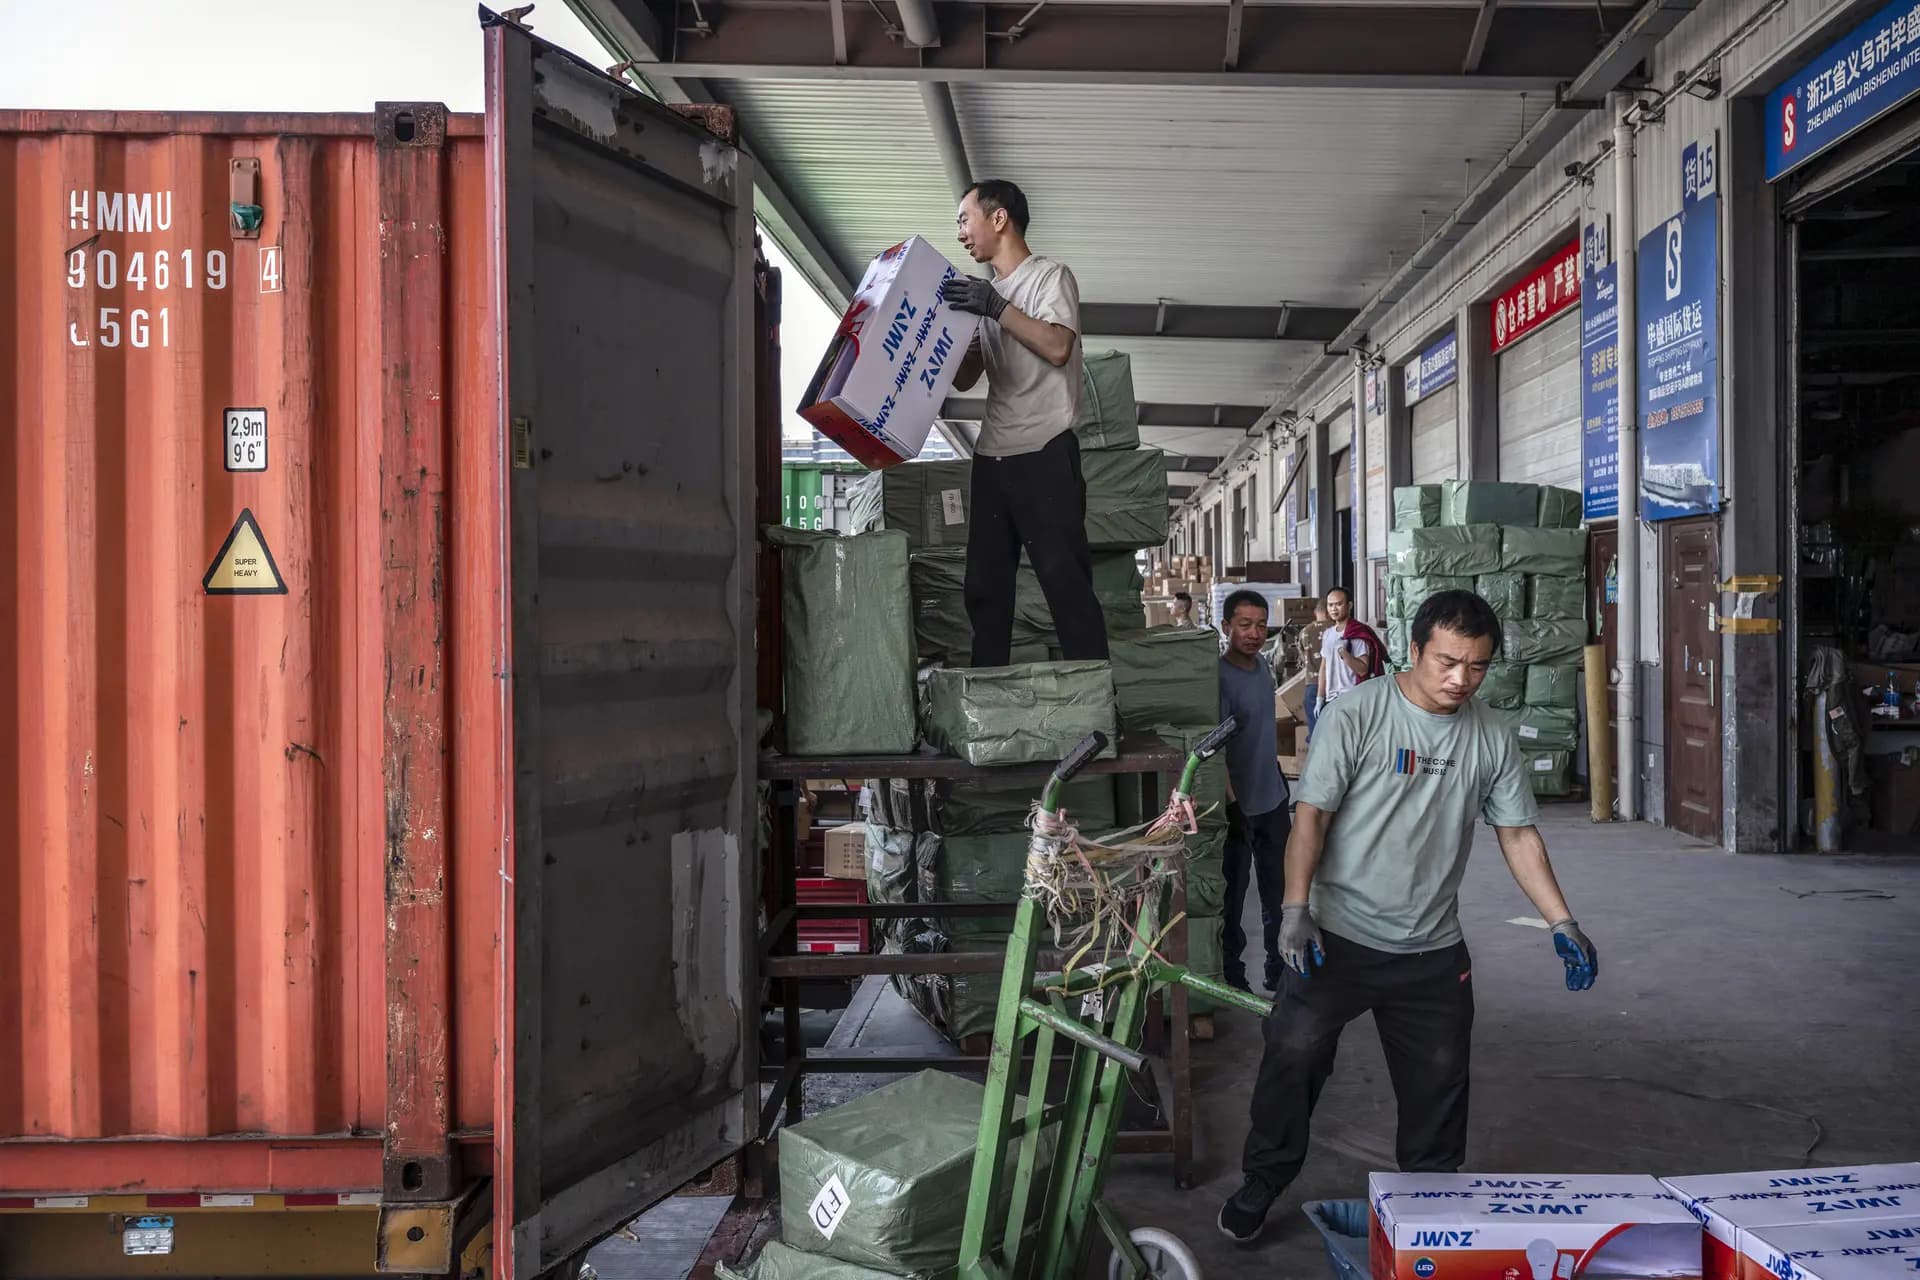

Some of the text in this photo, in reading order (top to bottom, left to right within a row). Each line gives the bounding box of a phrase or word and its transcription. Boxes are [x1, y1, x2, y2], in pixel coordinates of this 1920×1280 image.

[1807, 101, 1842, 133] ZHEJIANG
[1844, 88, 1863, 110] YIWU
[1864, 62, 1900, 96] BISHENG
[1684, 144, 1714, 199] 货 15
[70, 191, 172, 232] HMMU
[1595, 227, 1607, 258] 14
[67, 250, 280, 289] 904619 4
[1507, 276, 1547, 333] 仓库重地
[230, 417, 263, 441] 2,9m
[234, 558, 257, 566] SUPER
[234, 569, 258, 578] HEAVY
[816, 1186, 842, 1228] ED
